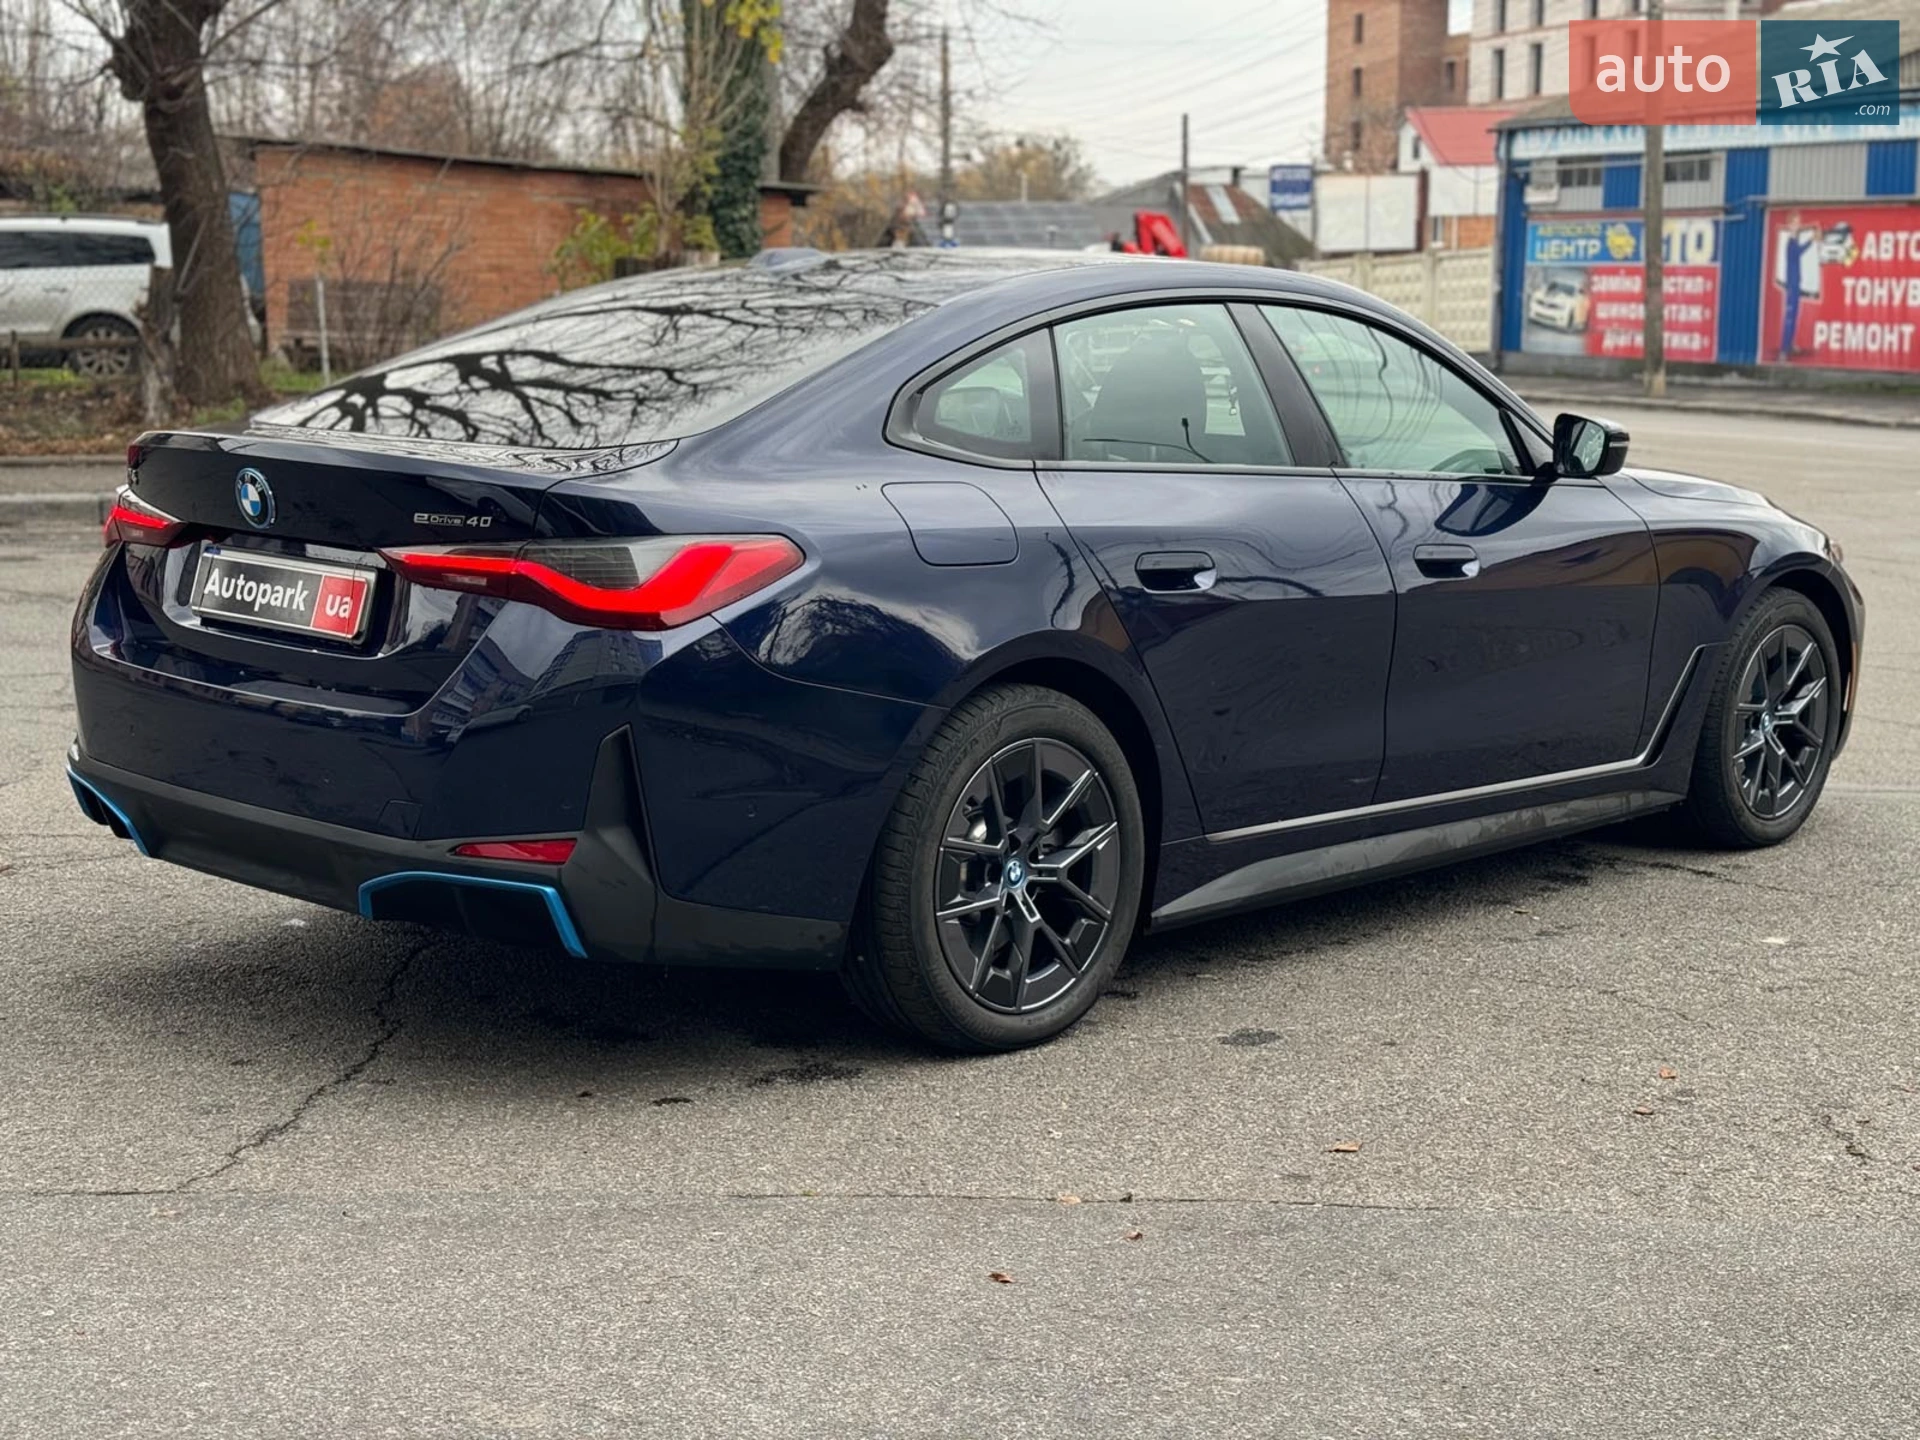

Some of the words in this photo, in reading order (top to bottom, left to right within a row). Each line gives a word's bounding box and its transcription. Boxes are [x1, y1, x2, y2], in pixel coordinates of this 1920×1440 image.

[1536, 239, 1601, 260] ЦЕНТР
[1813, 320, 1915, 353] РЕМОНТ
[466, 516, 492, 527] 40
[204, 568, 309, 612] Autopark
[325, 593, 353, 619] ua
